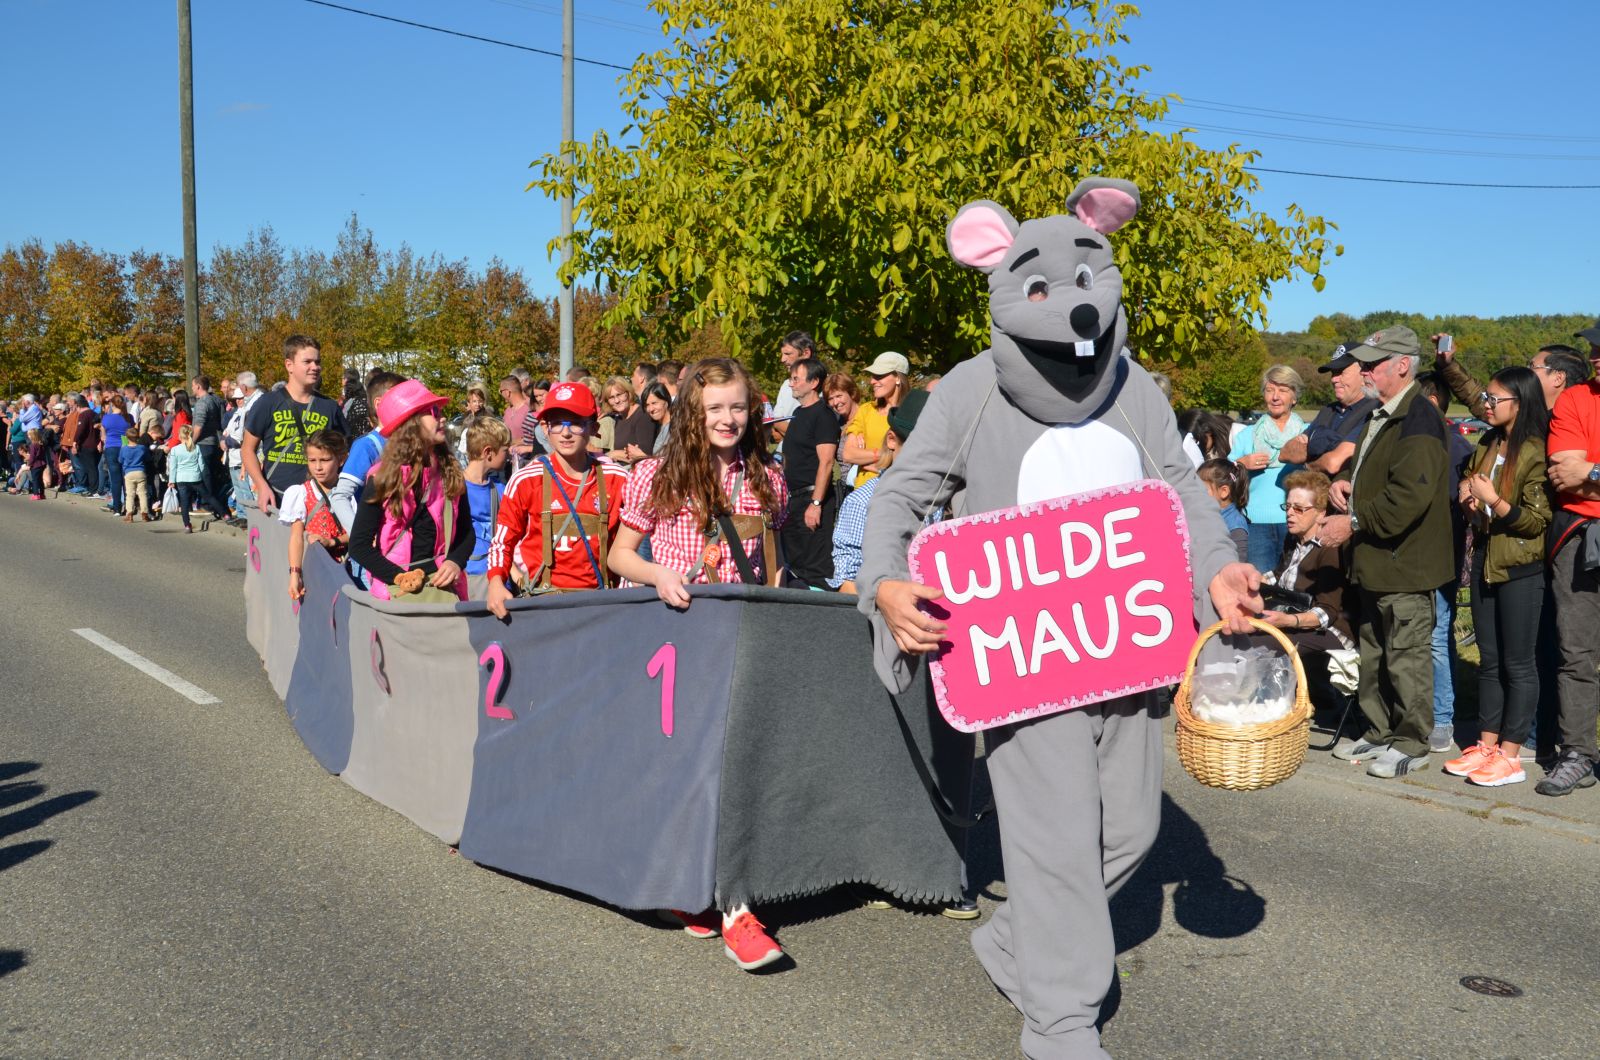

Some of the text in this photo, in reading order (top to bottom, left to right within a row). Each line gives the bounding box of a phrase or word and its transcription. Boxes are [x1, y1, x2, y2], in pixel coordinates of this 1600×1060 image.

[273, 409, 329, 427] GURDS
[935, 507, 1146, 605] WILDE
[969, 580, 1174, 686] MAUS
[479, 642, 515, 720] 2
[646, 643, 676, 737] 1
